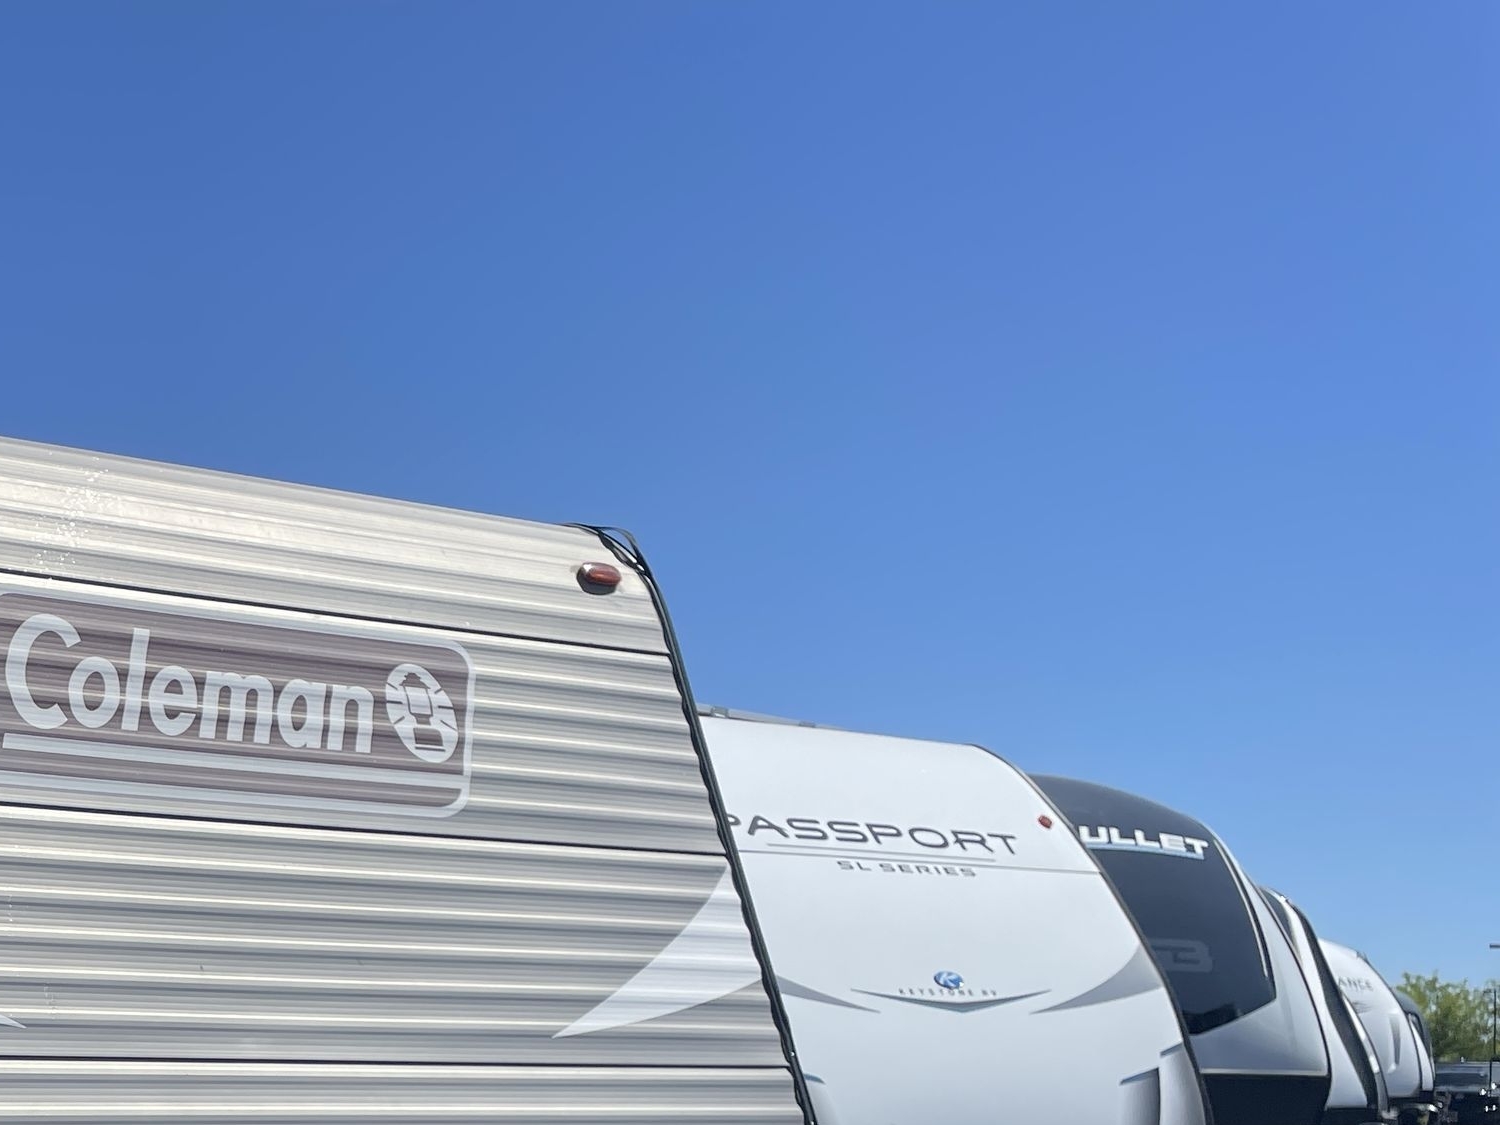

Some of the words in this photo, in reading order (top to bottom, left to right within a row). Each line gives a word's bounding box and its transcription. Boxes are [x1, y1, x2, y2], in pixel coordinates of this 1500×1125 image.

[5, 613, 374, 753] Coleman
[836, 860, 872, 872] SL
[879, 863, 976, 878] SERIES
